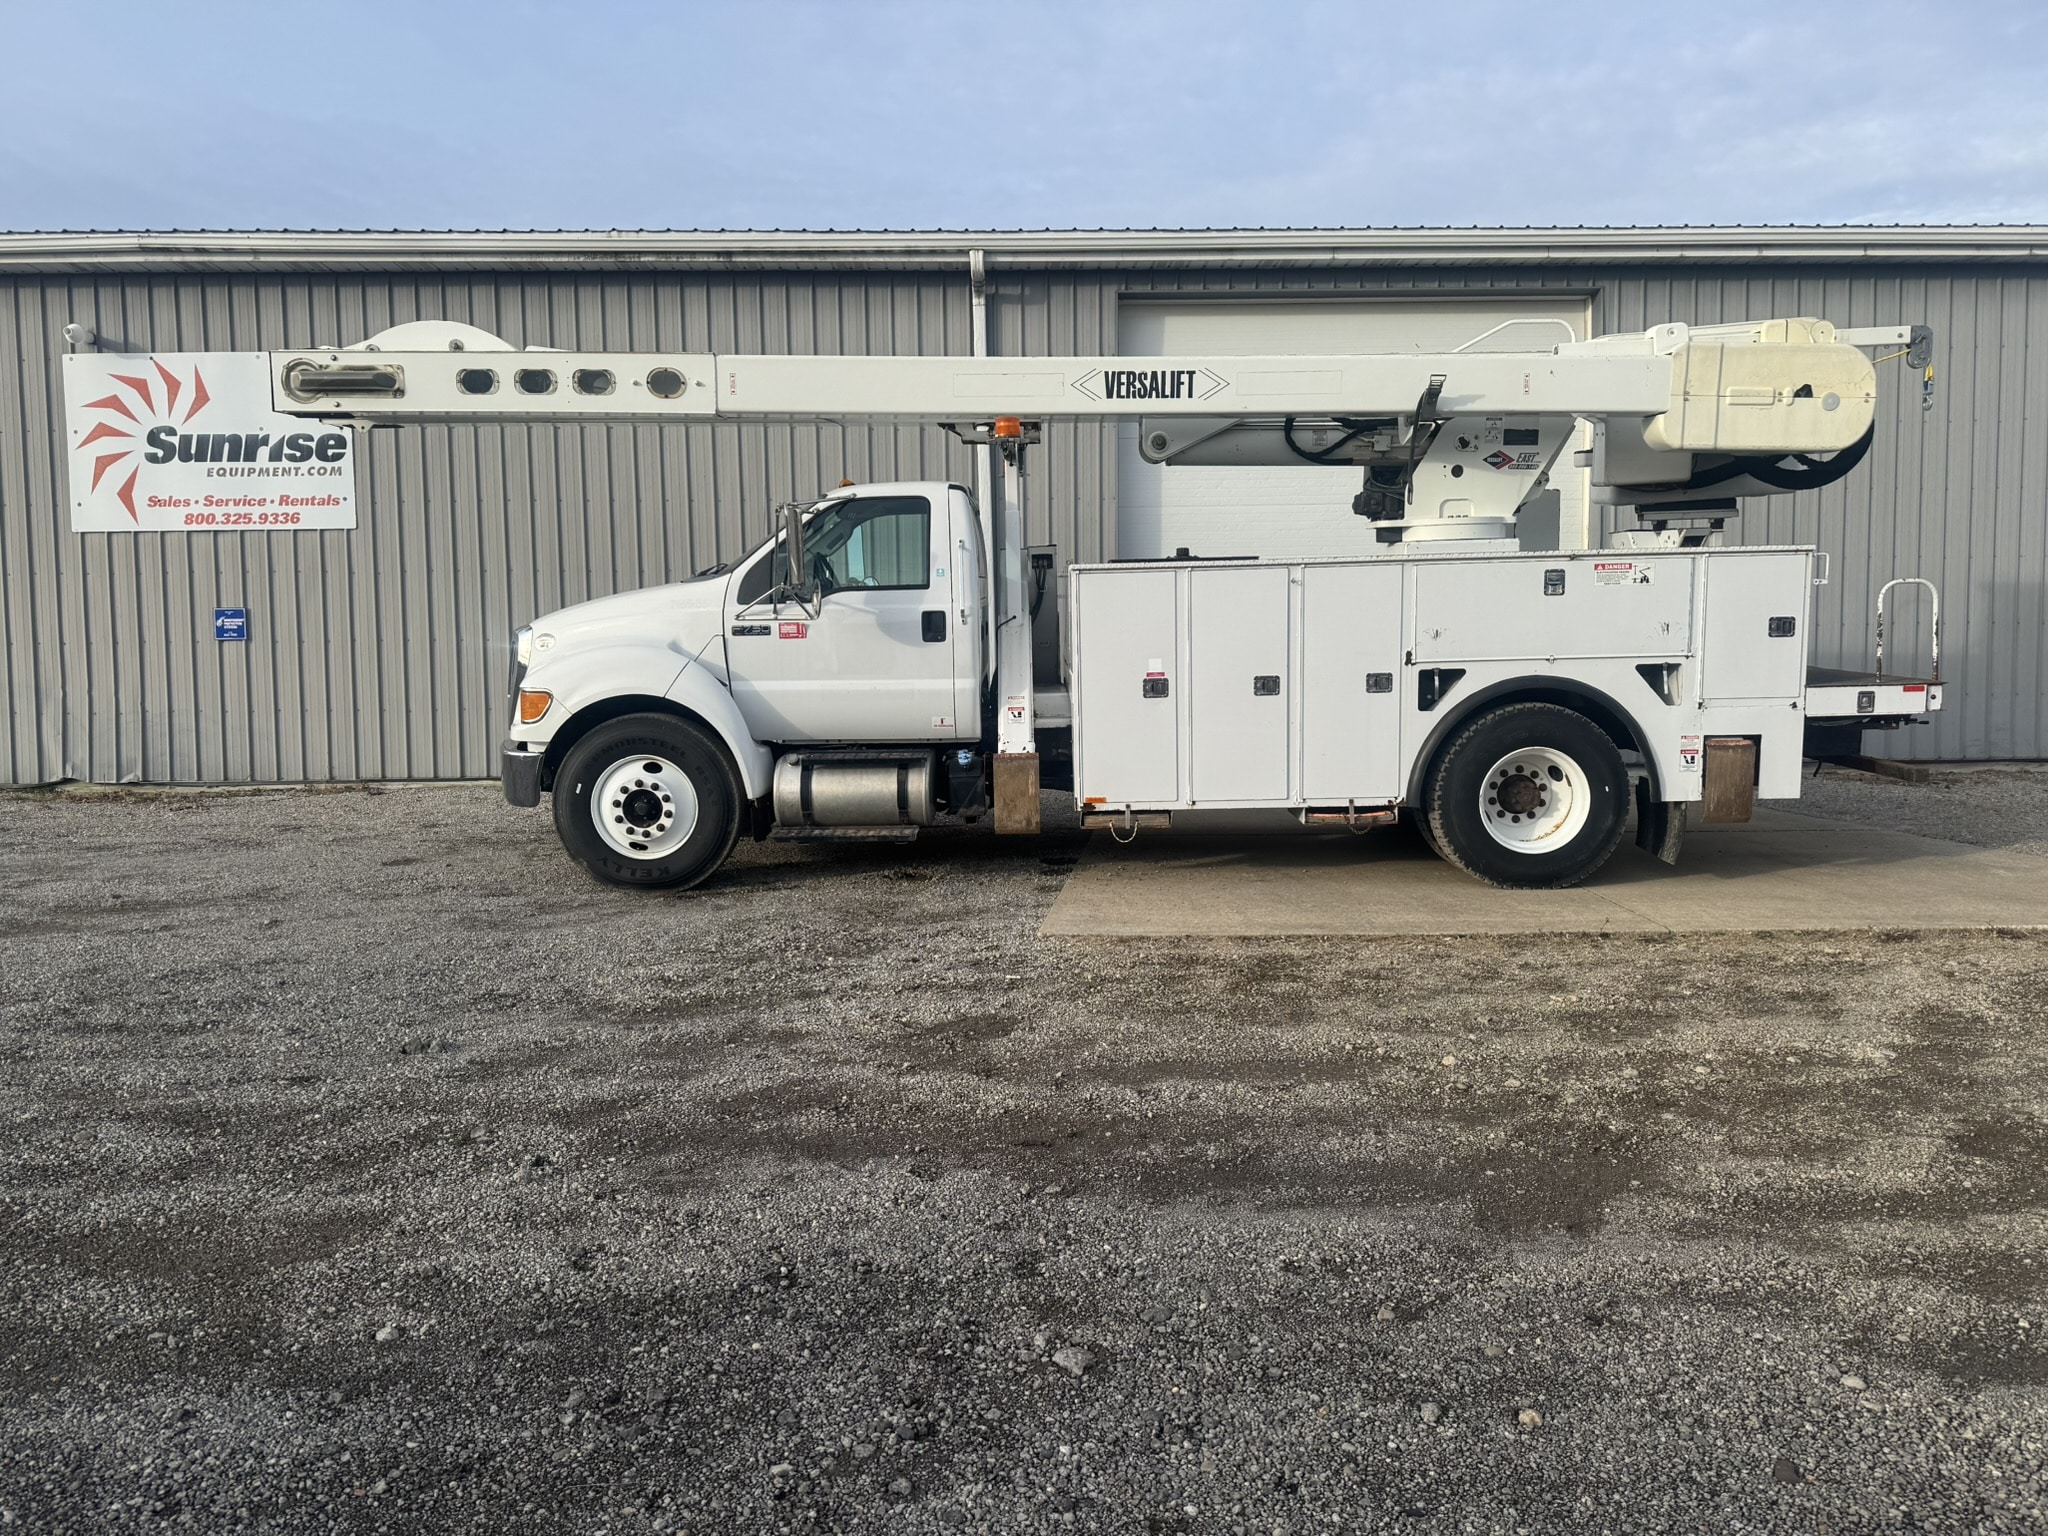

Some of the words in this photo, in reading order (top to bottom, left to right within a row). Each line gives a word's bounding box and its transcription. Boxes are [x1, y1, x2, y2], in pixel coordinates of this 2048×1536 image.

[1104, 370, 1196, 399] VERSALIFT
[144, 425, 347, 464] Sunrise
[206, 466, 343, 478] EQUIPMENT.COM
[147, 495, 191, 508] Sales
[203, 494, 266, 507] Service
[278, 494, 340, 506] Rentals
[184, 512, 301, 525] 800.325.9336
[596, 856, 671, 878] KELLY
